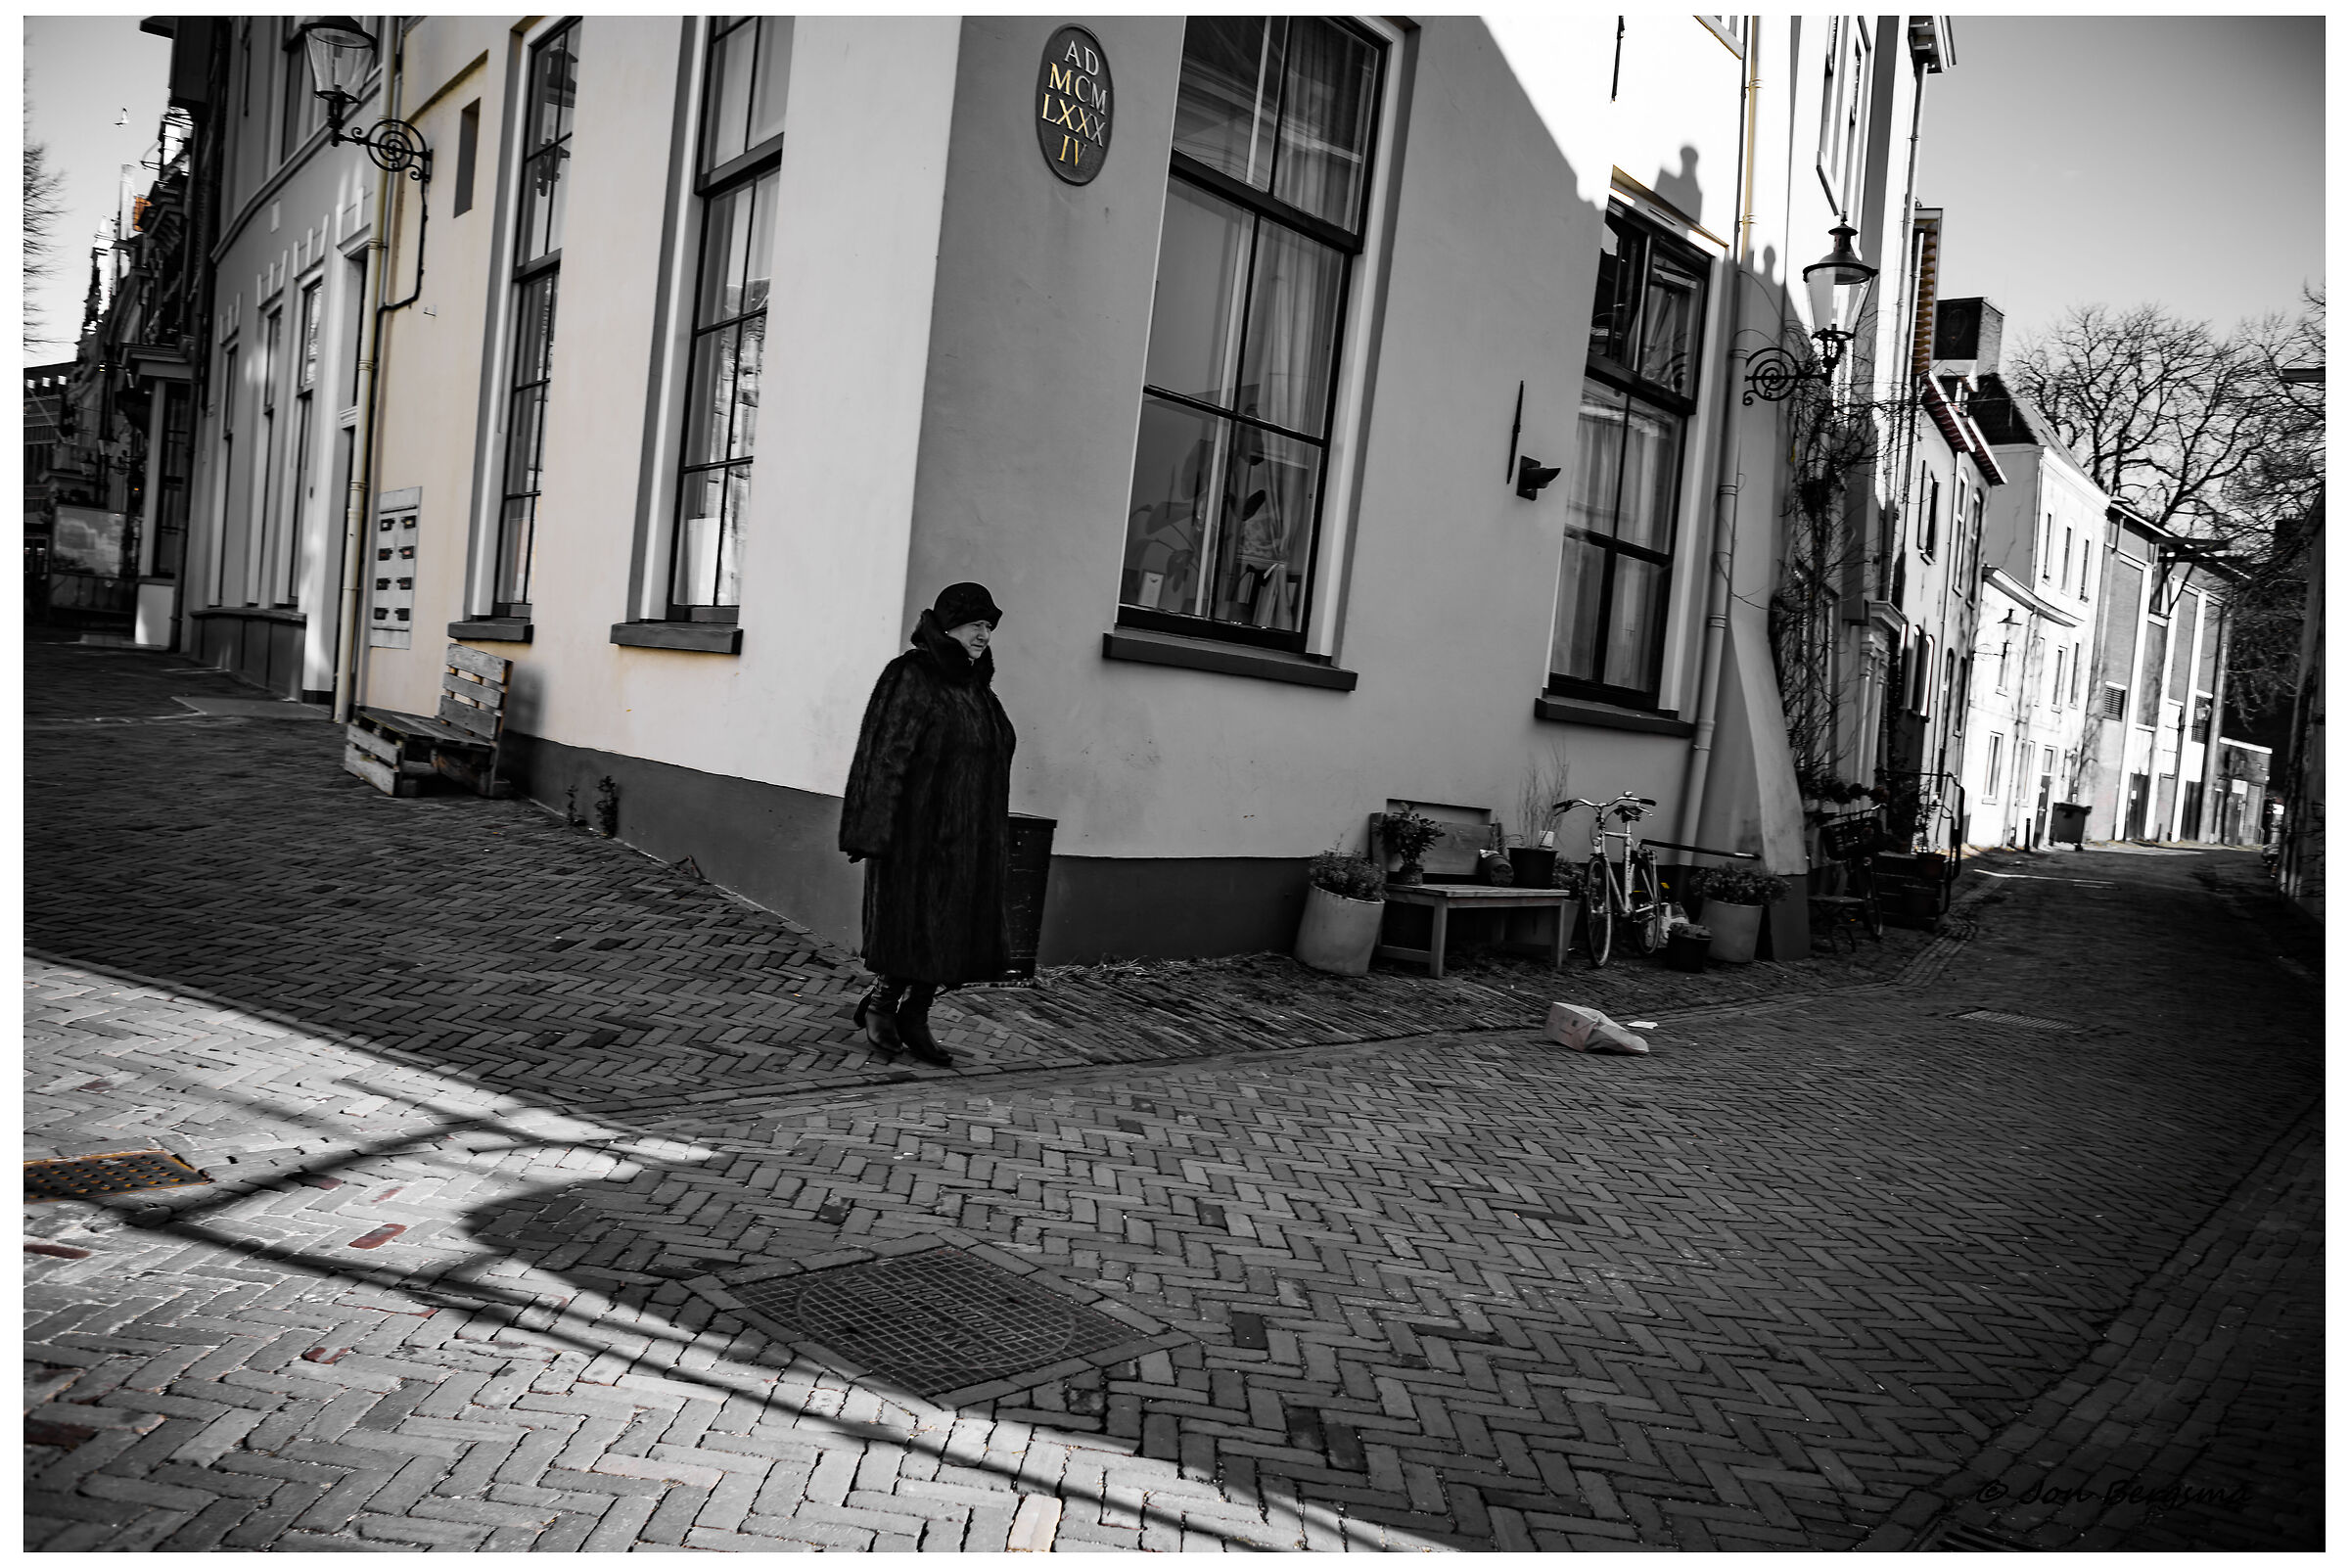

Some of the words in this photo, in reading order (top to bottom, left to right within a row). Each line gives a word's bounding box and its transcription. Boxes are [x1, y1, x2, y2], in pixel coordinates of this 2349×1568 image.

[1064, 40, 1099, 76] AD
[1048, 62, 1108, 115] MCM
[1041, 93, 1106, 147] LXXX
[1058, 134, 1087, 166] IV
